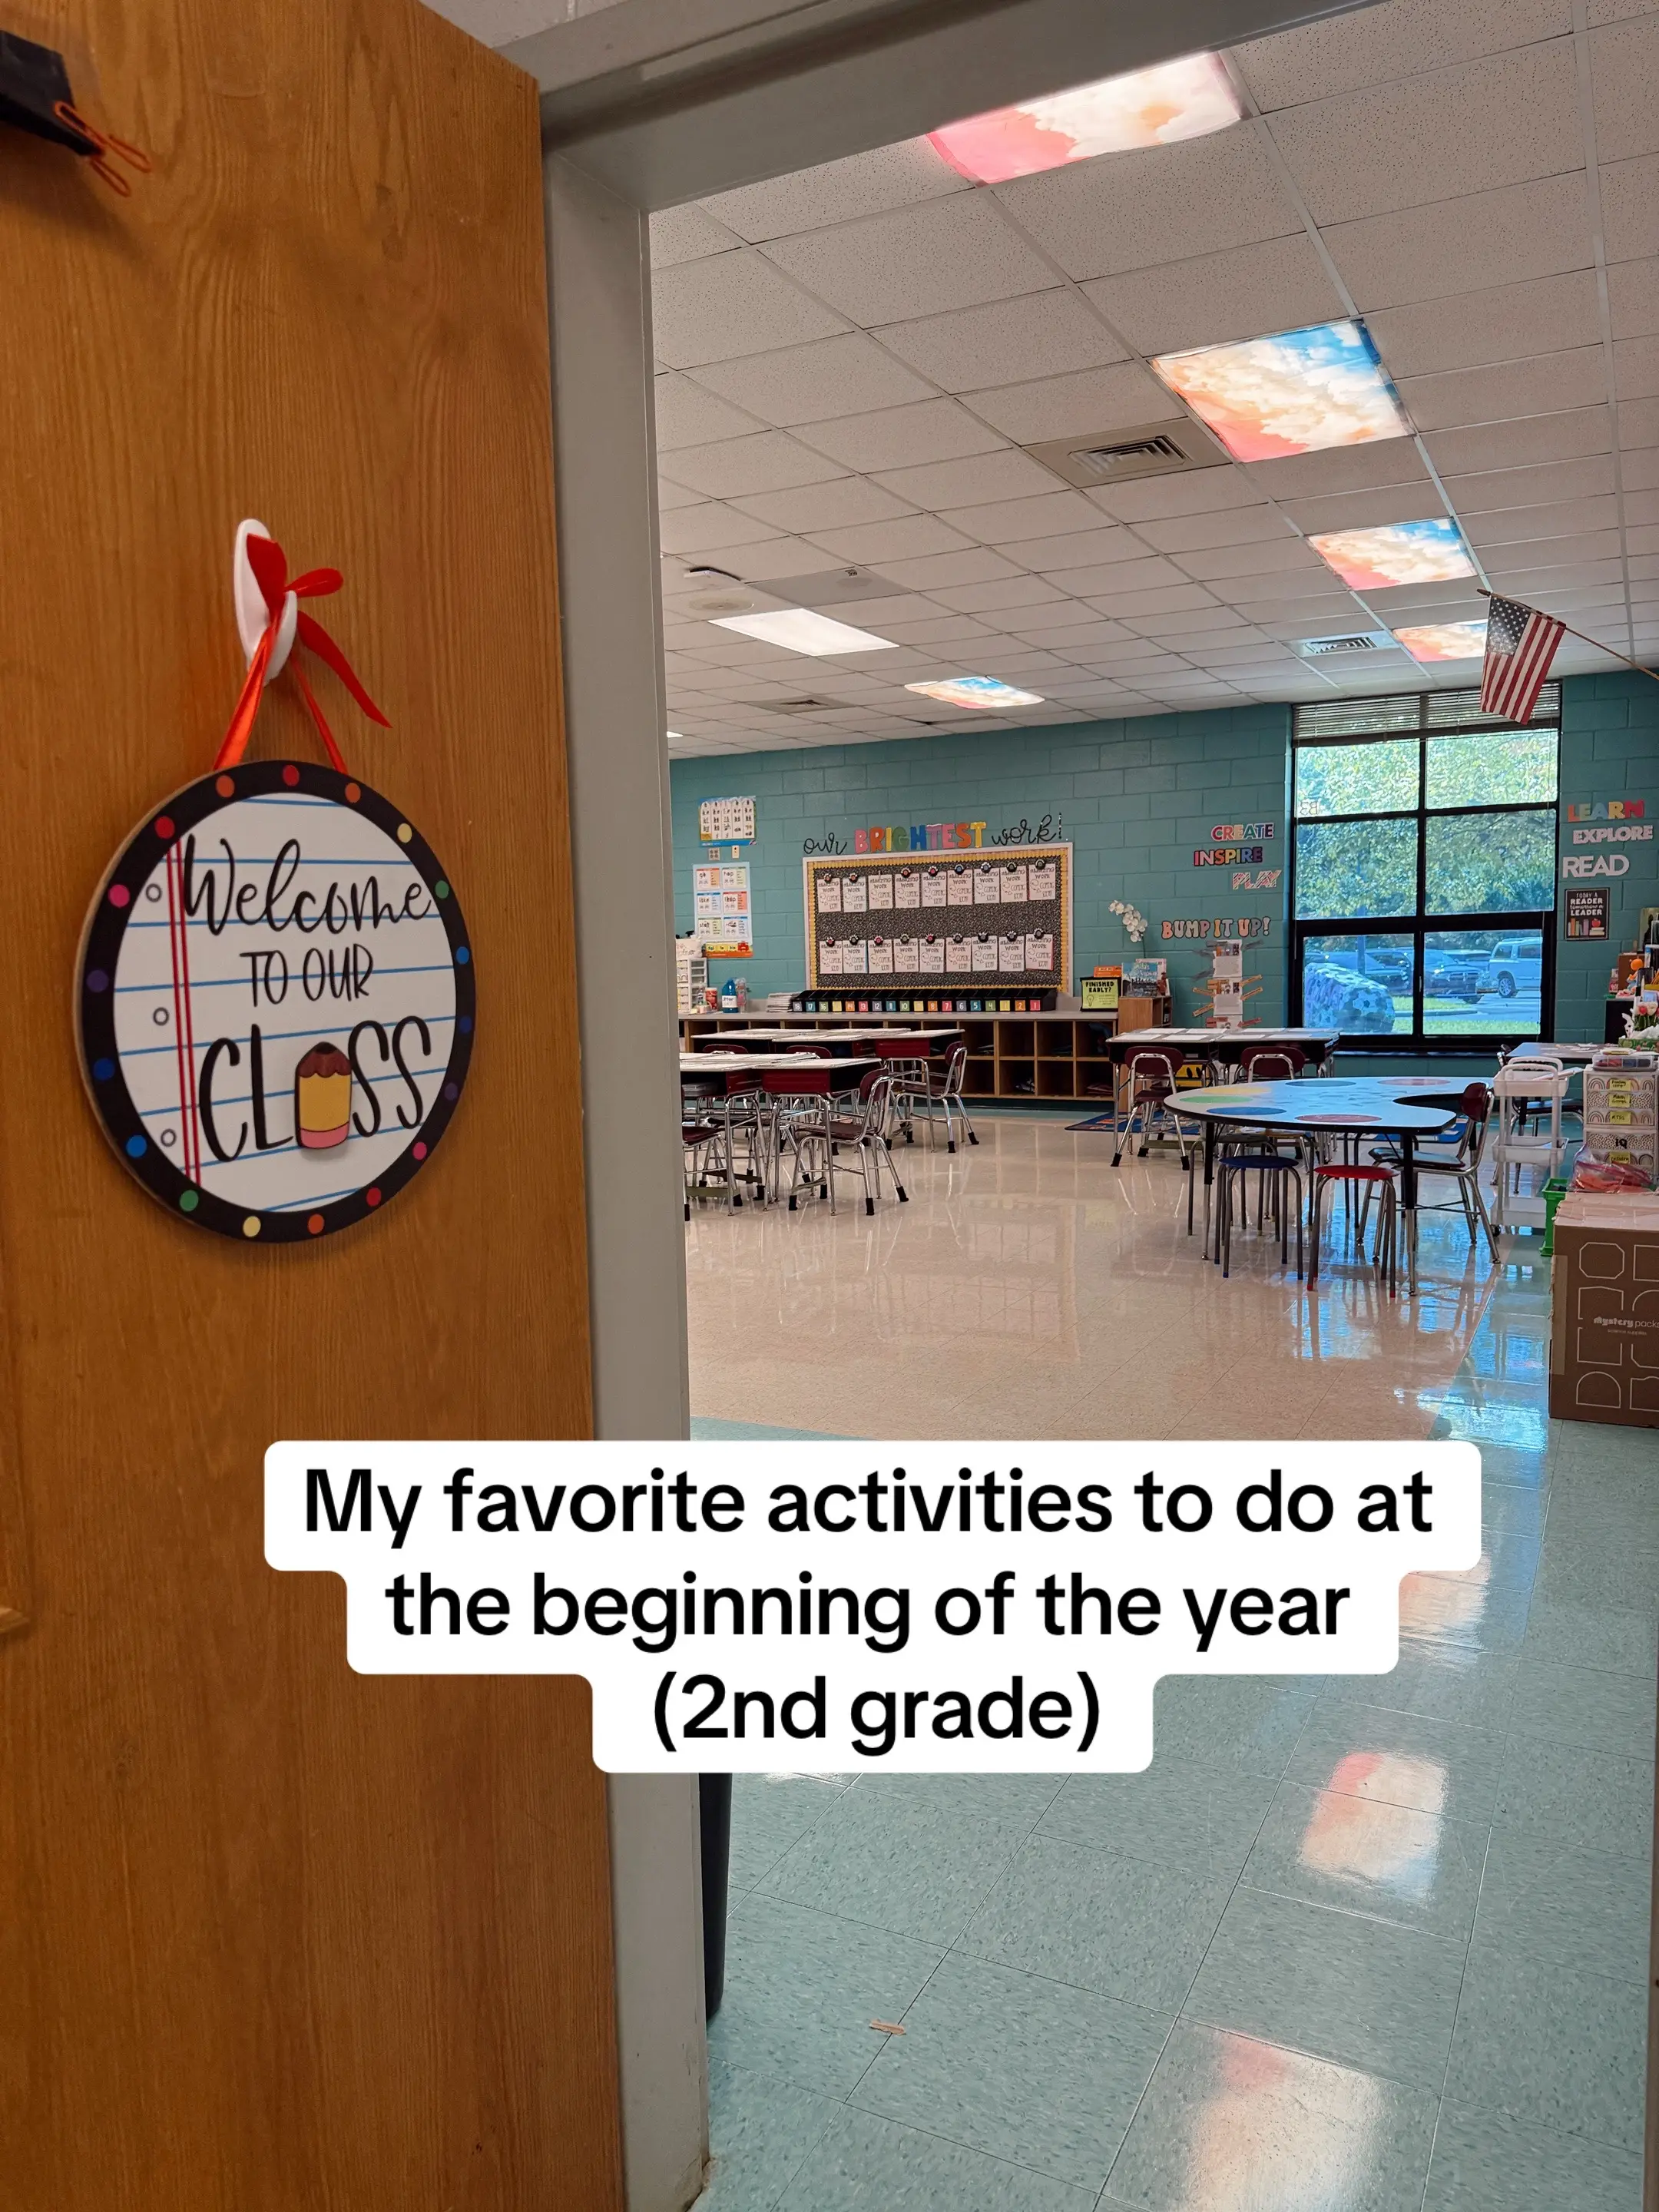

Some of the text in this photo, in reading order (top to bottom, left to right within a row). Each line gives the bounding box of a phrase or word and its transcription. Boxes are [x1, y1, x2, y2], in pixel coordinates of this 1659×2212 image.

[1568, 799, 1645, 823] LEARN
[803, 832, 847, 854] our
[854, 821, 986, 853] BRIGHTEST
[1211, 823, 1274, 841] CREATE
[1573, 825, 1653, 845] EXPLORE
[1194, 846, 1262, 866] INSPIRE
[1562, 854, 1630, 878] READ
[184, 833, 432, 935] Welcome
[1232, 869, 1281, 889] PLAY
[1161, 916, 1271, 939] BUMP IT UP!
[239, 943, 374, 1007] TO OUR
[199, 1015, 432, 1162] CLSS
